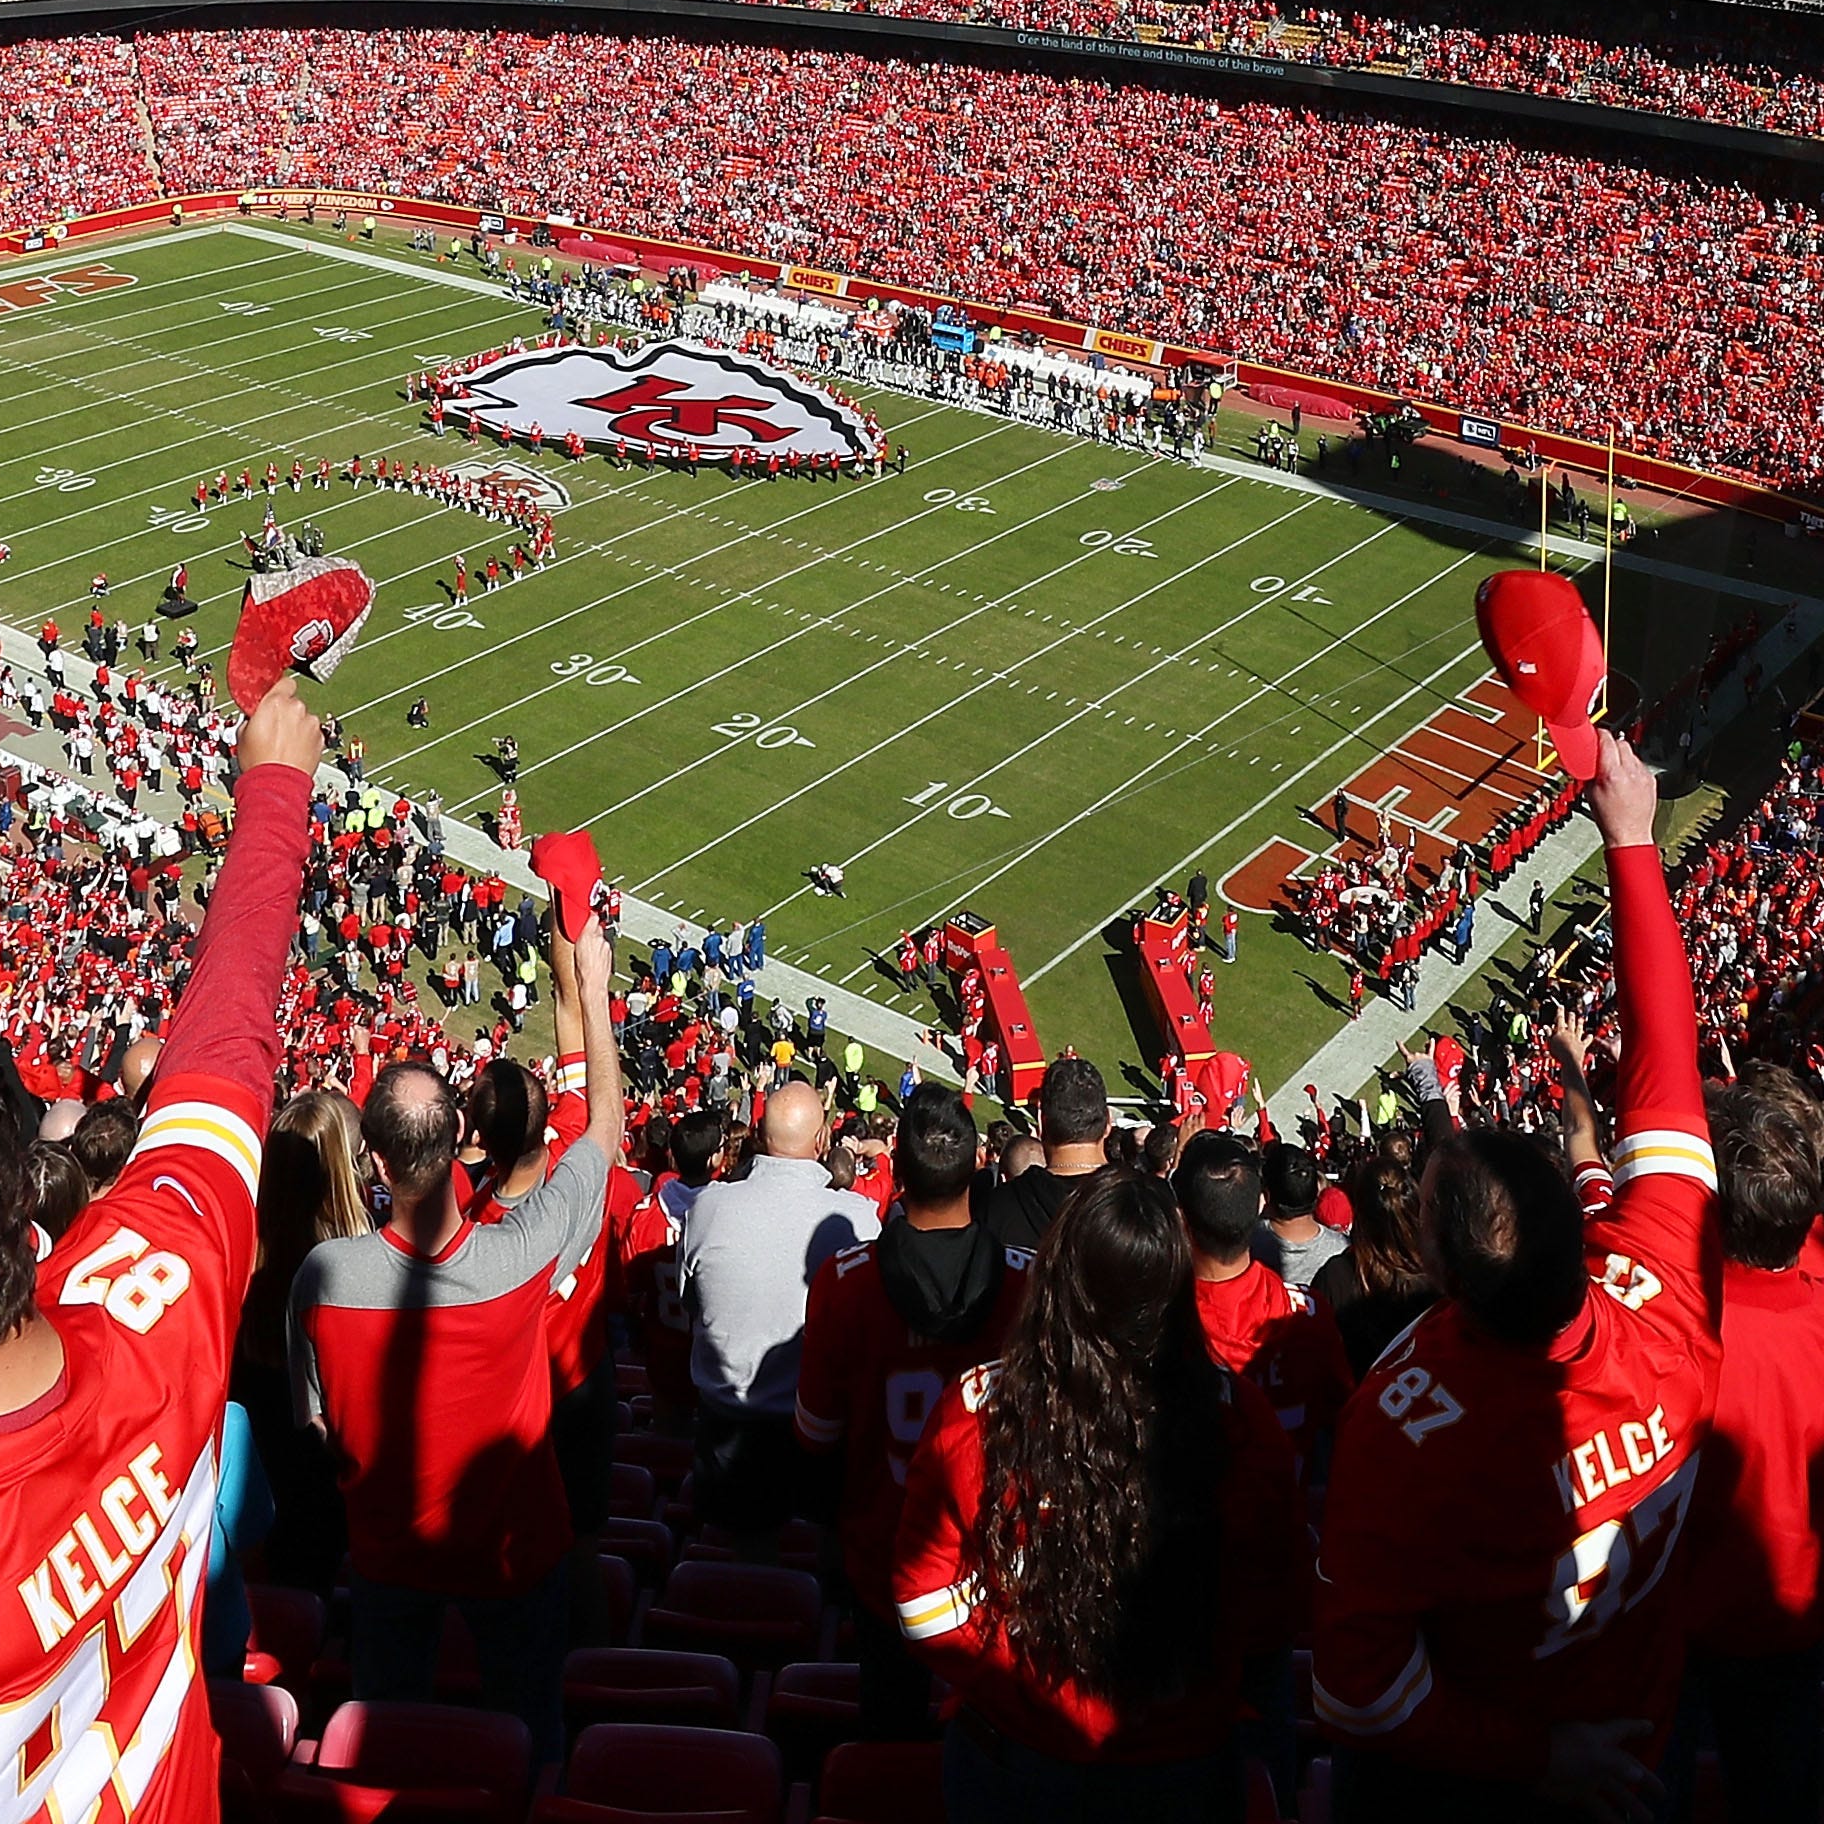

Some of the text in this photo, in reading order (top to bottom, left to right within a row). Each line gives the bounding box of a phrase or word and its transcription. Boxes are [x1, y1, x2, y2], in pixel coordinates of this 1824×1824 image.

[1017, 33, 1284, 76] O'er the land of the free and the home of the brave
[269, 193, 315, 205] CHIEFS
[316, 195, 377, 209] KINGDOM
[793, 271, 836, 291] CHIEFS
[1099, 336, 1148, 357] CHIEFS
[402, 602, 474, 630] 40
[550, 654, 627, 686] 30
[710, 712, 798, 749] 20
[902, 781, 992, 819] 10
[57, 1225, 193, 1336] 87
[1378, 1365, 1467, 1448] 87
[1552, 1402, 1675, 1515] KELCE
[16, 1440, 183, 1654] KELCE
